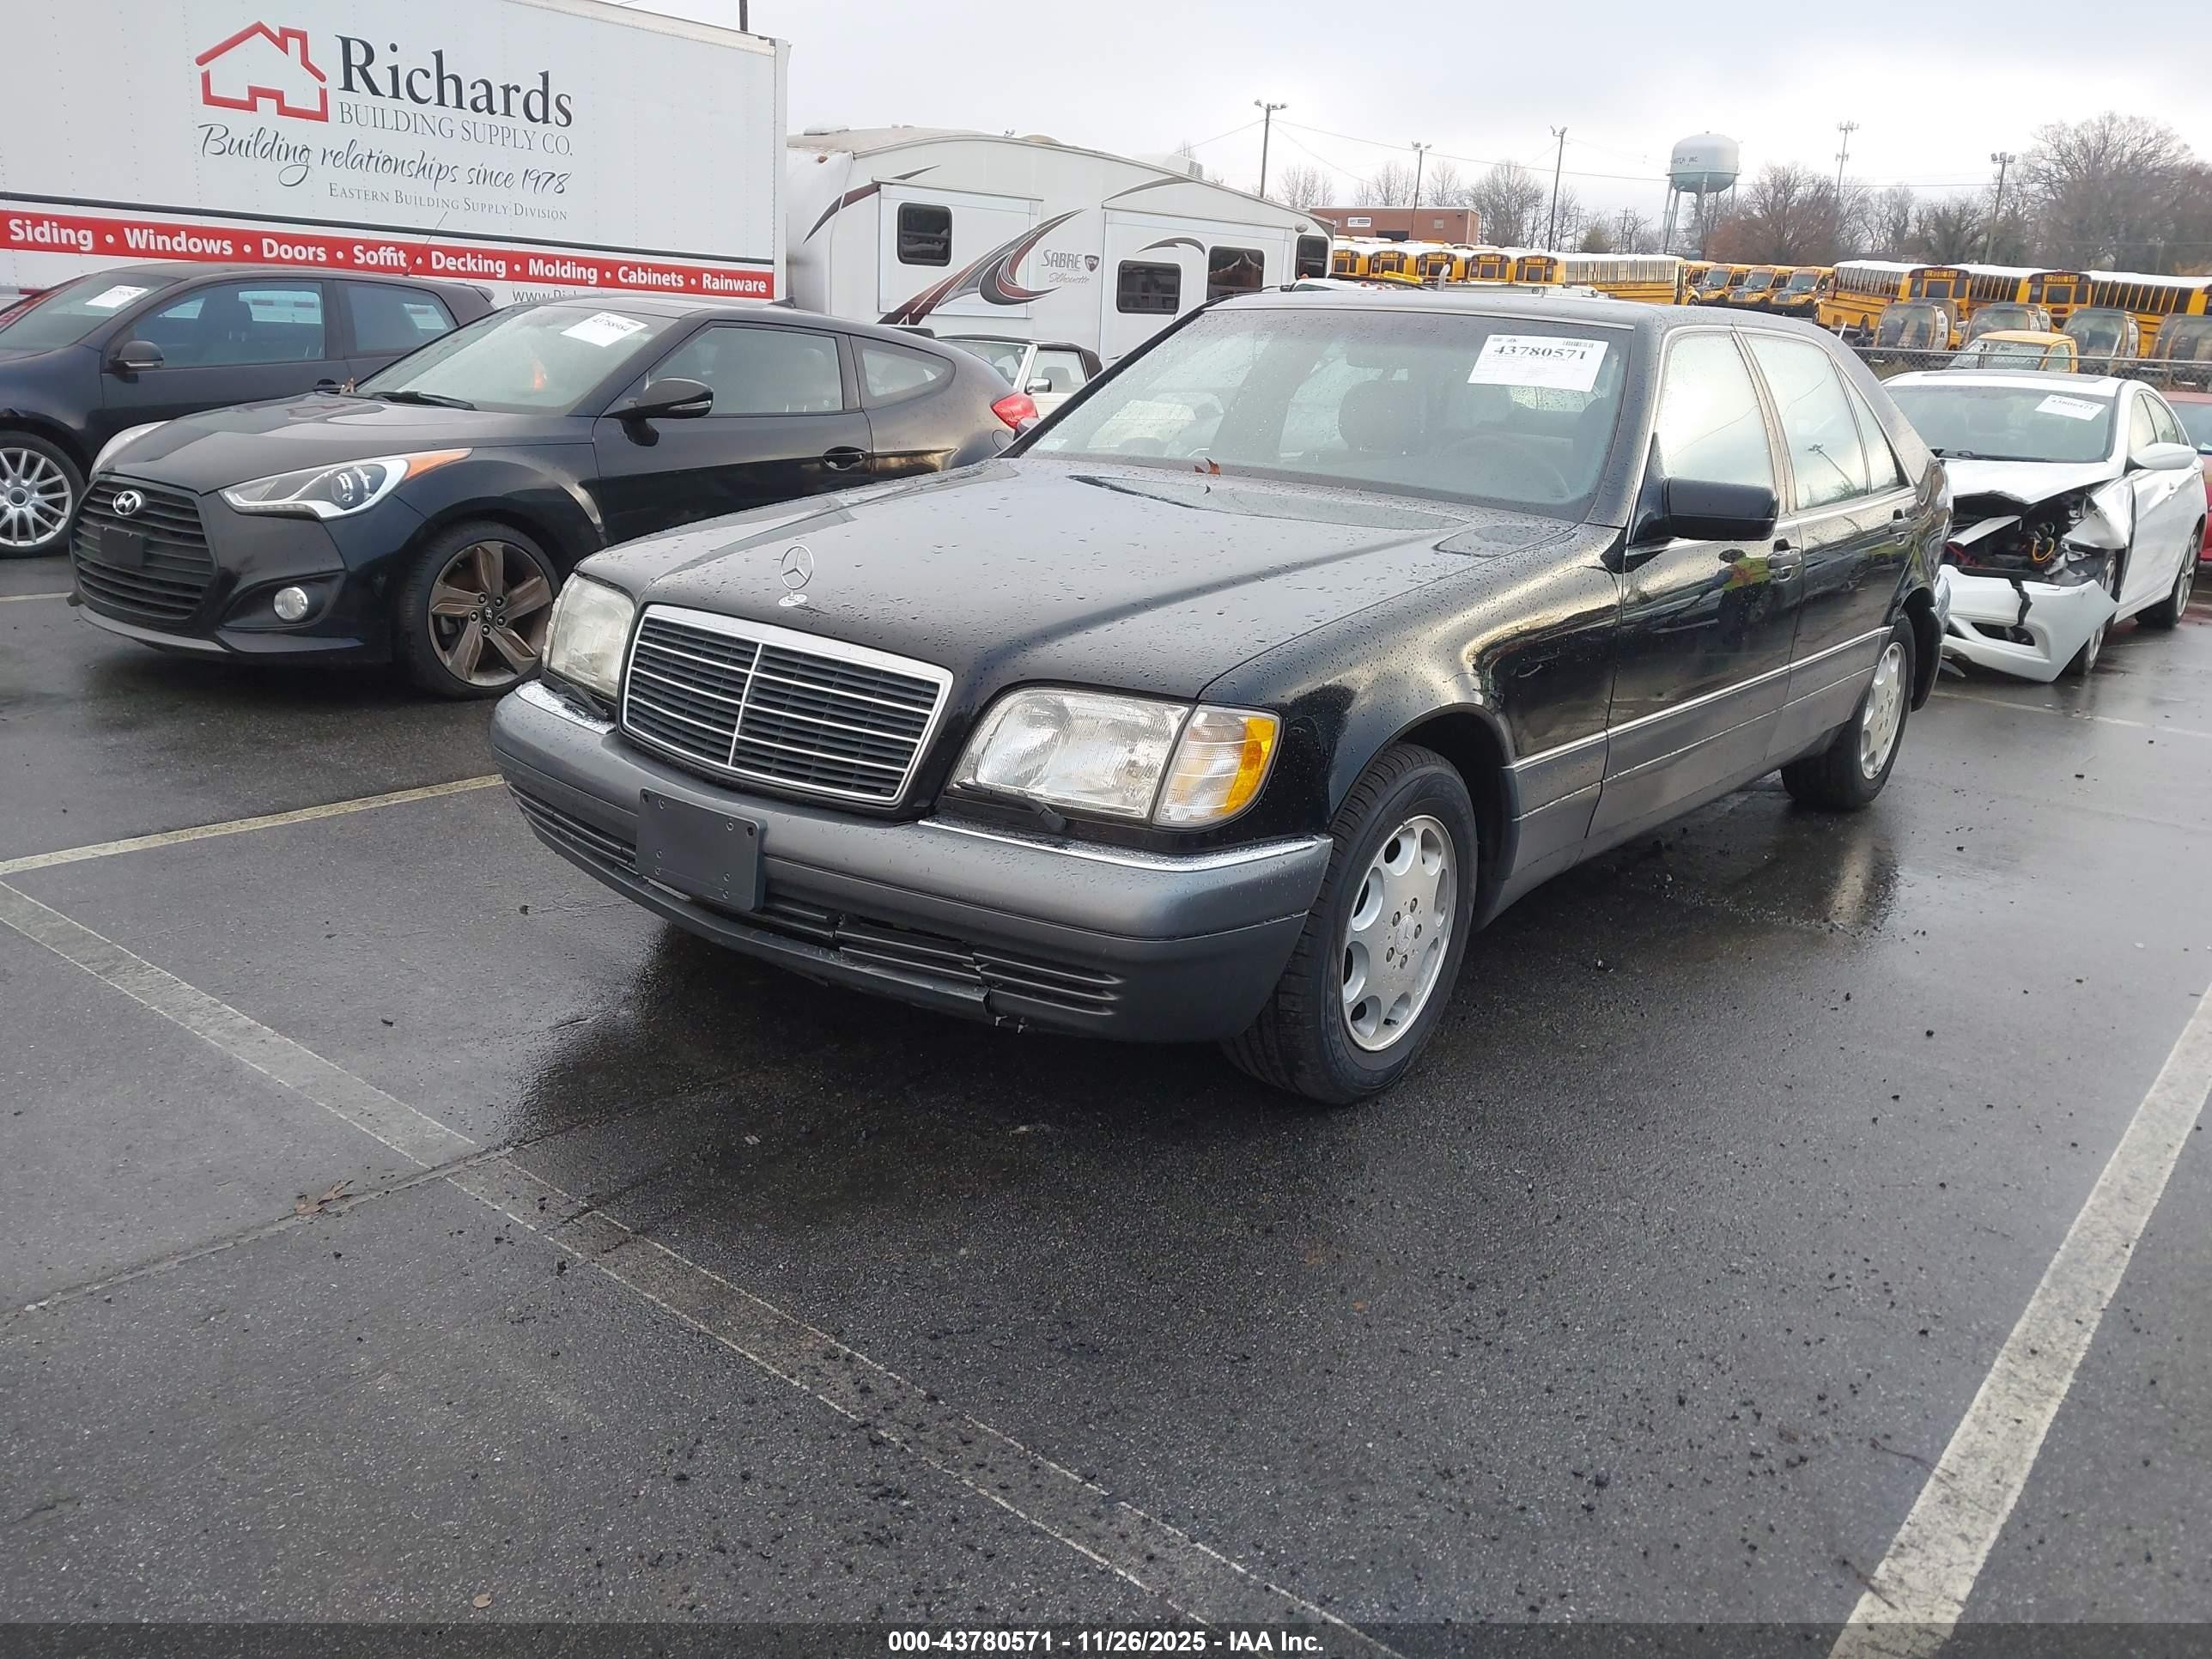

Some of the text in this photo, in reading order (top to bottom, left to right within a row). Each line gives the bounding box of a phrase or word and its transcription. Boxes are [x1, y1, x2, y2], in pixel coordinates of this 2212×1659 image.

[335, 34, 573, 128] Richards
[198, 123, 573, 195] Building relationships since 1978
[338, 101, 574, 156] BUILDING SUPPLY CO.
[9, 218, 768, 294] Siding Windows Doors Soffit Decking Molding Cabinets Rainware
[1041, 249, 1083, 270] SABRE
[1494, 345, 1587, 360] 43780571
